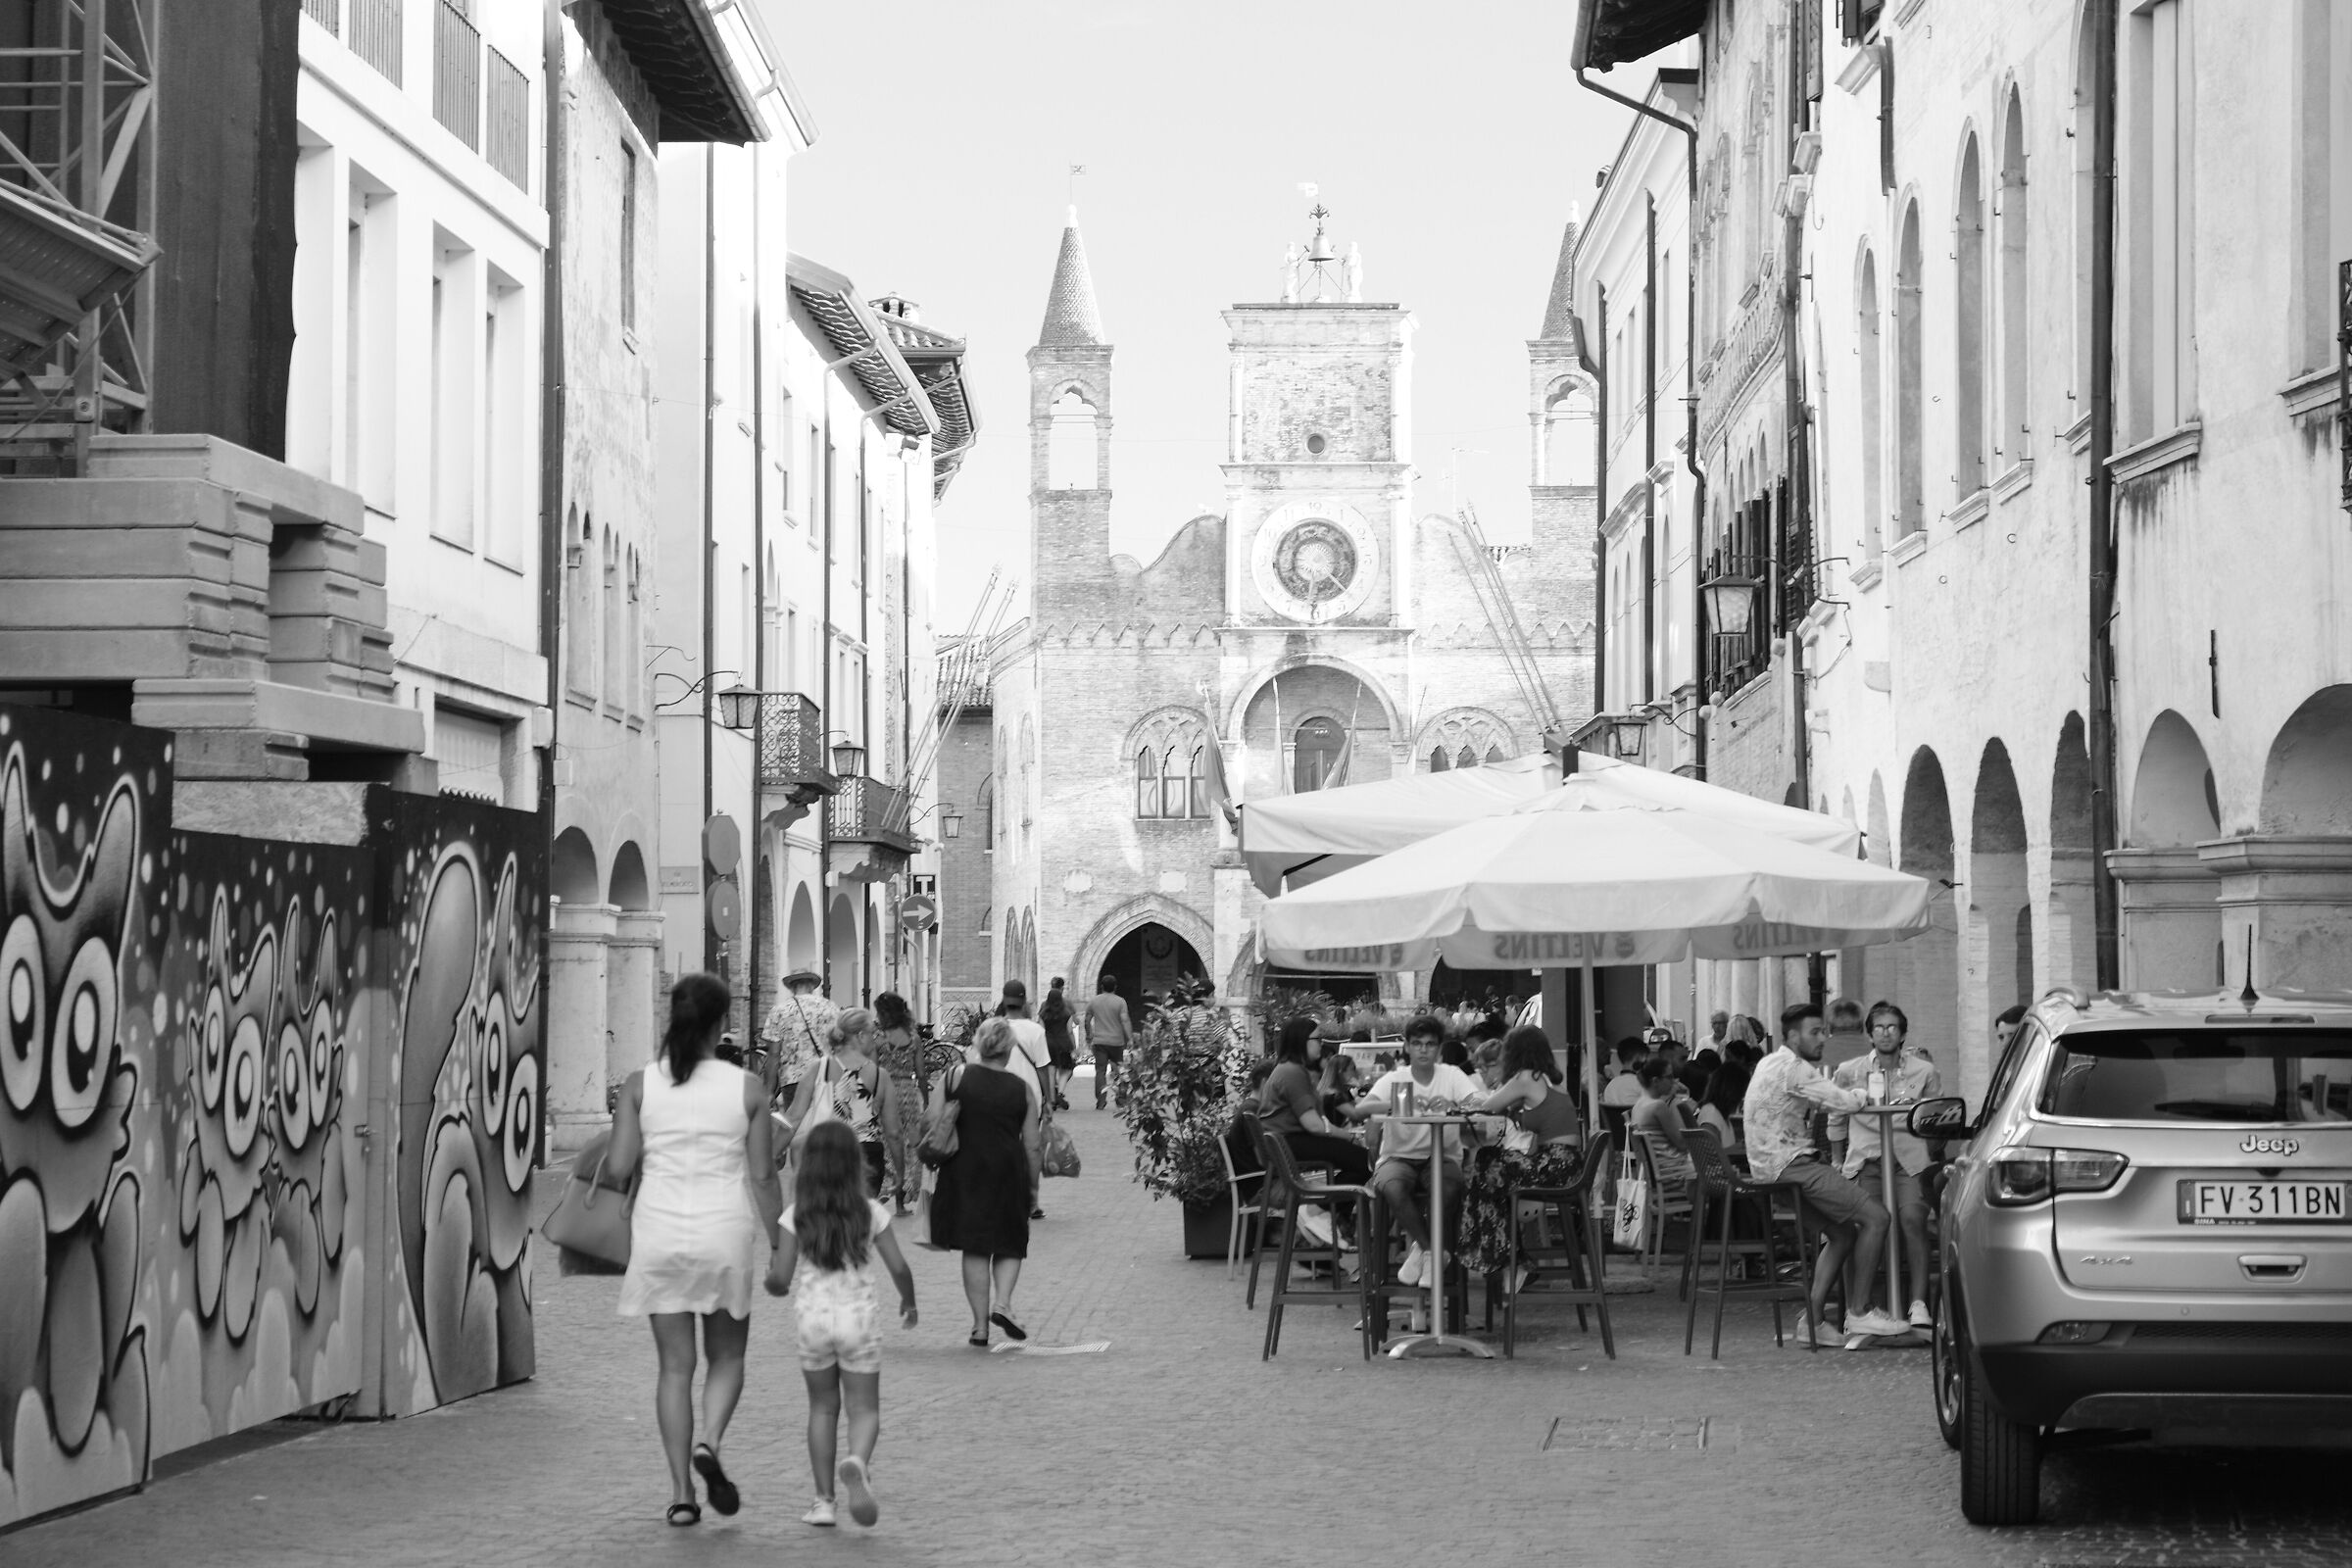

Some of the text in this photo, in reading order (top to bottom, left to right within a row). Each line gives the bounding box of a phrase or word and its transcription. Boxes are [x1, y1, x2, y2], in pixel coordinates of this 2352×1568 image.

[2240, 1135, 2299, 1156] Jeep
[2200, 1186, 2340, 1214] FV 311BN
[2080, 1255, 2133, 1265] 4x4
